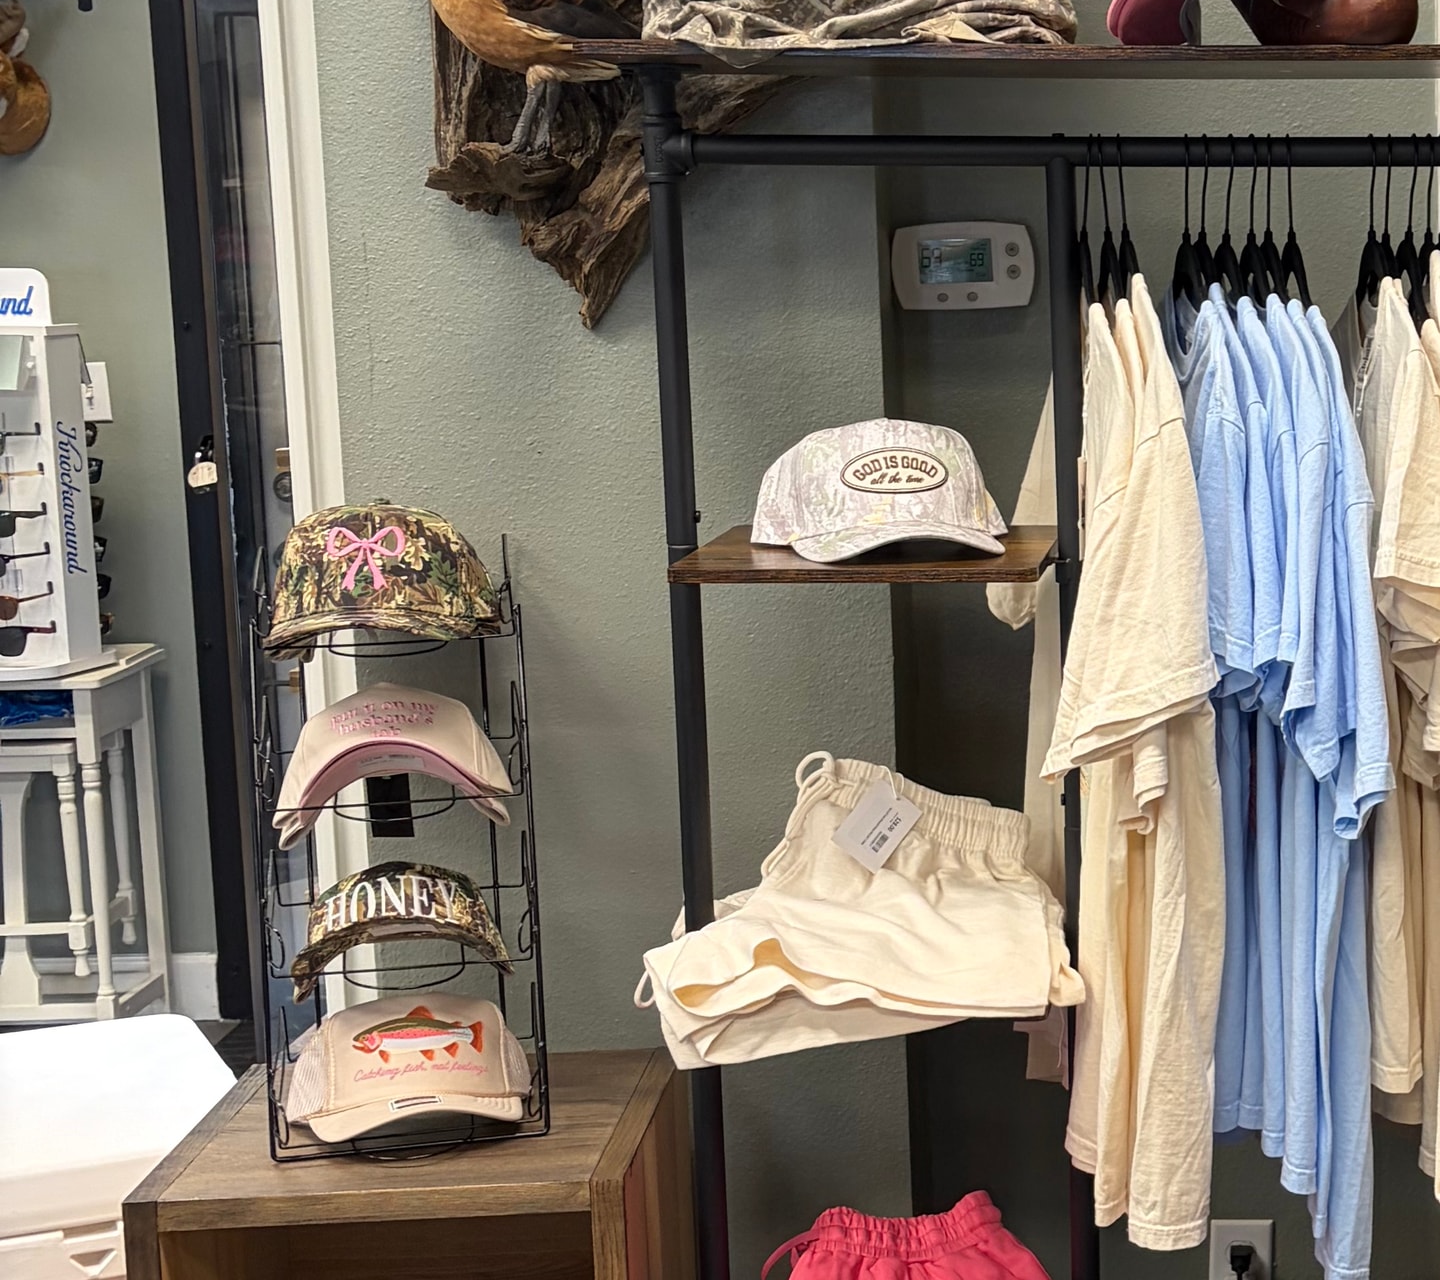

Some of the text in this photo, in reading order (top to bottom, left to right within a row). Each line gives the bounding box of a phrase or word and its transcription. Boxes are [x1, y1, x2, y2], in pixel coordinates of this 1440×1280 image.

[970, 253, 984, 267] 69
[853, 456, 939, 481] GOD IS GOOD
[870, 472, 924, 485] all the time
[57, 421, 87, 574] Knockaround
[324, 874, 466, 933] HONEY
